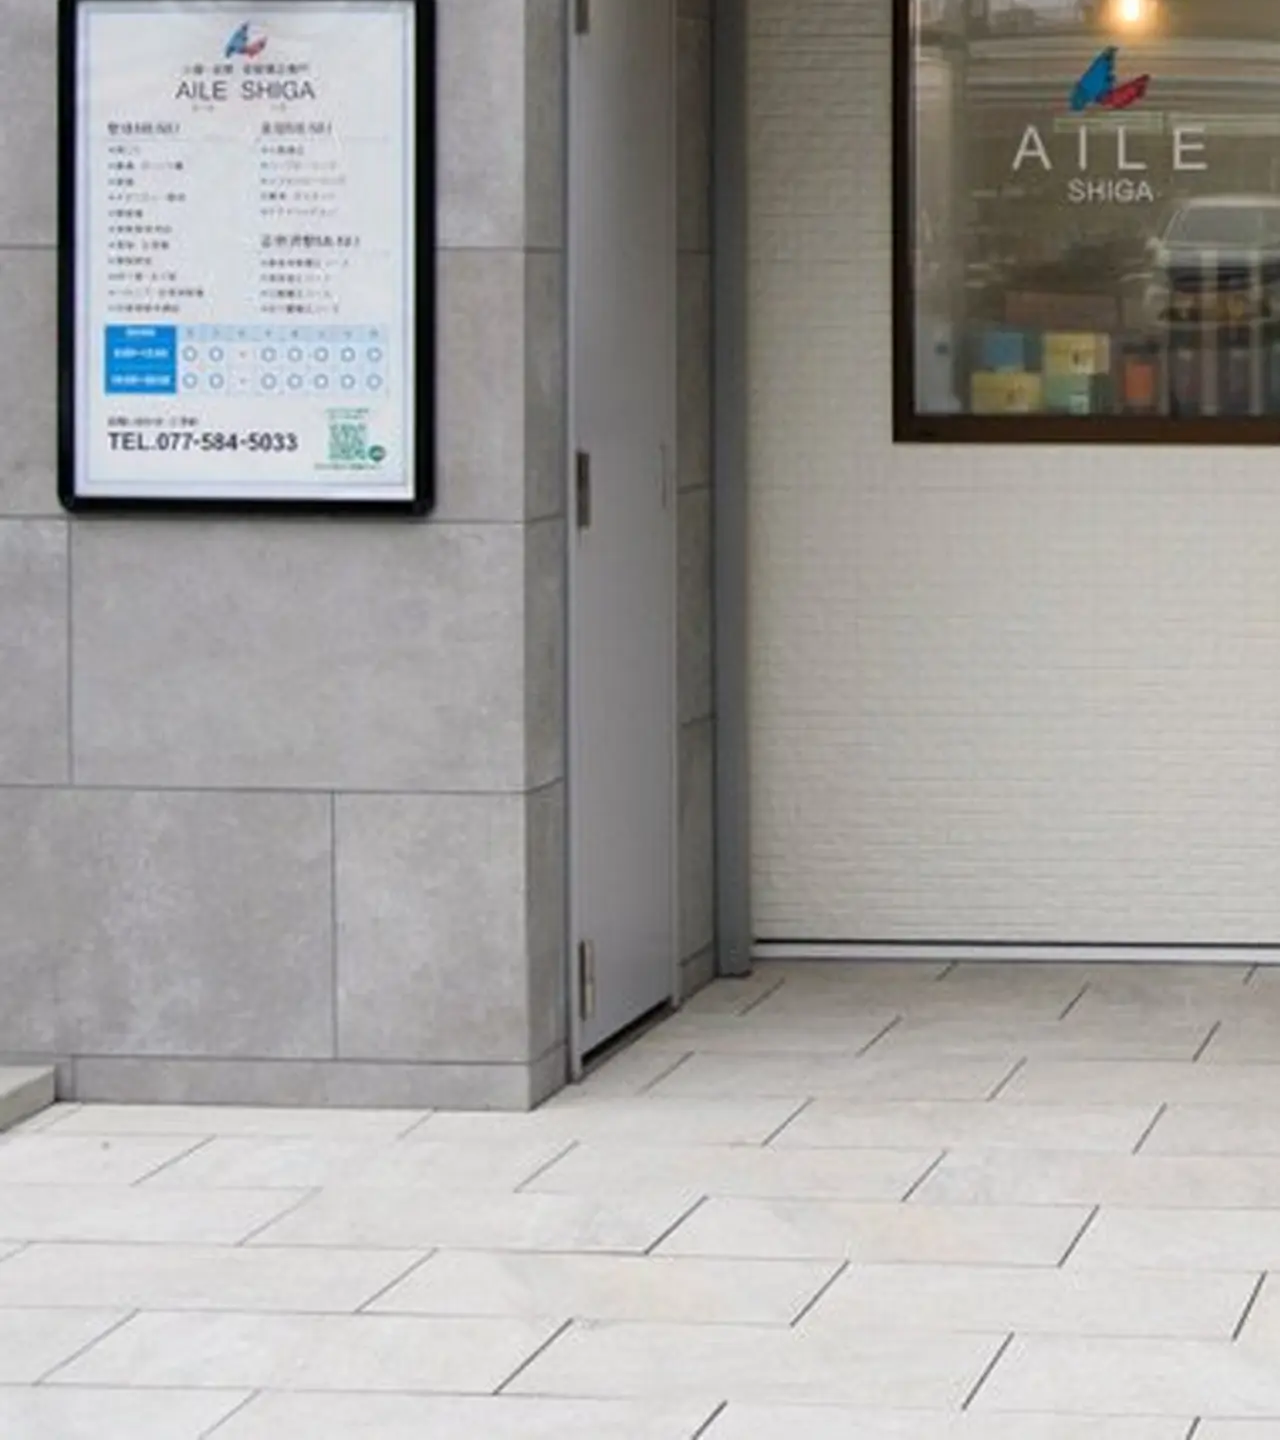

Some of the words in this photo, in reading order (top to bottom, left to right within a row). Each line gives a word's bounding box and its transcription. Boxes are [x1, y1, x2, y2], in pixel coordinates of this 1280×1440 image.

[175, 80, 228, 101] AILE
[241, 80, 316, 101] SHIGA
[1011, 125, 1209, 172] AILE
[1067, 178, 1154, 203] SHIGA
